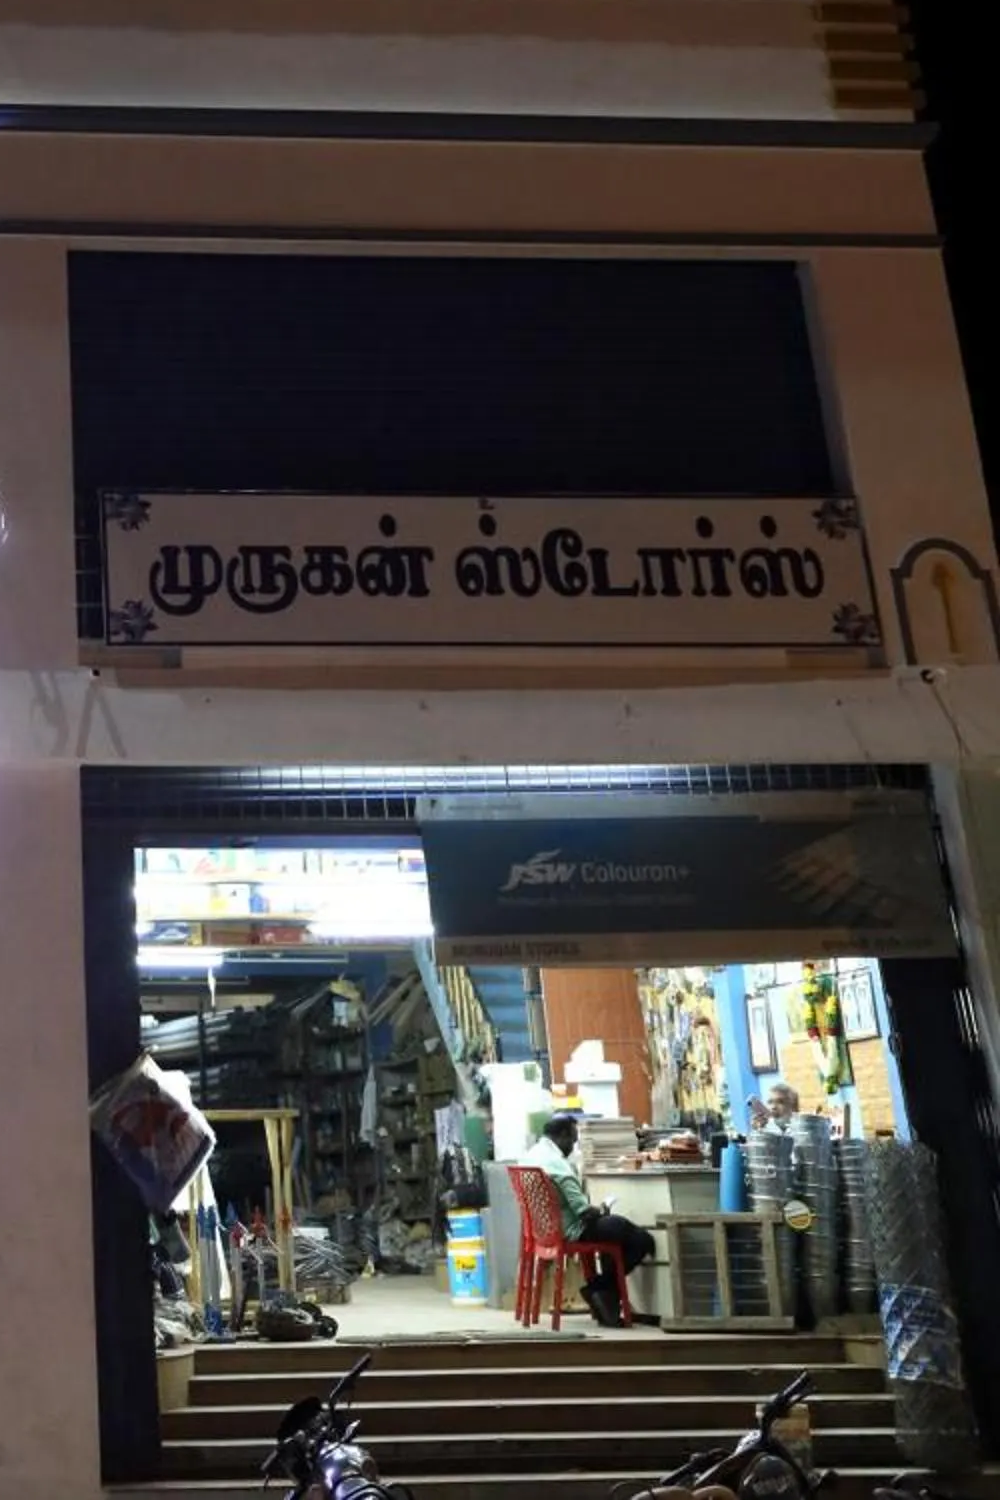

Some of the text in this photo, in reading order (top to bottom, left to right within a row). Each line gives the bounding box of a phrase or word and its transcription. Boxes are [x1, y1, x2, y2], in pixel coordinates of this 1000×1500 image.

[149, 513, 825, 617] முருகன் ஸ்டோர்ஸ்
[499, 858, 576, 892] JSW
